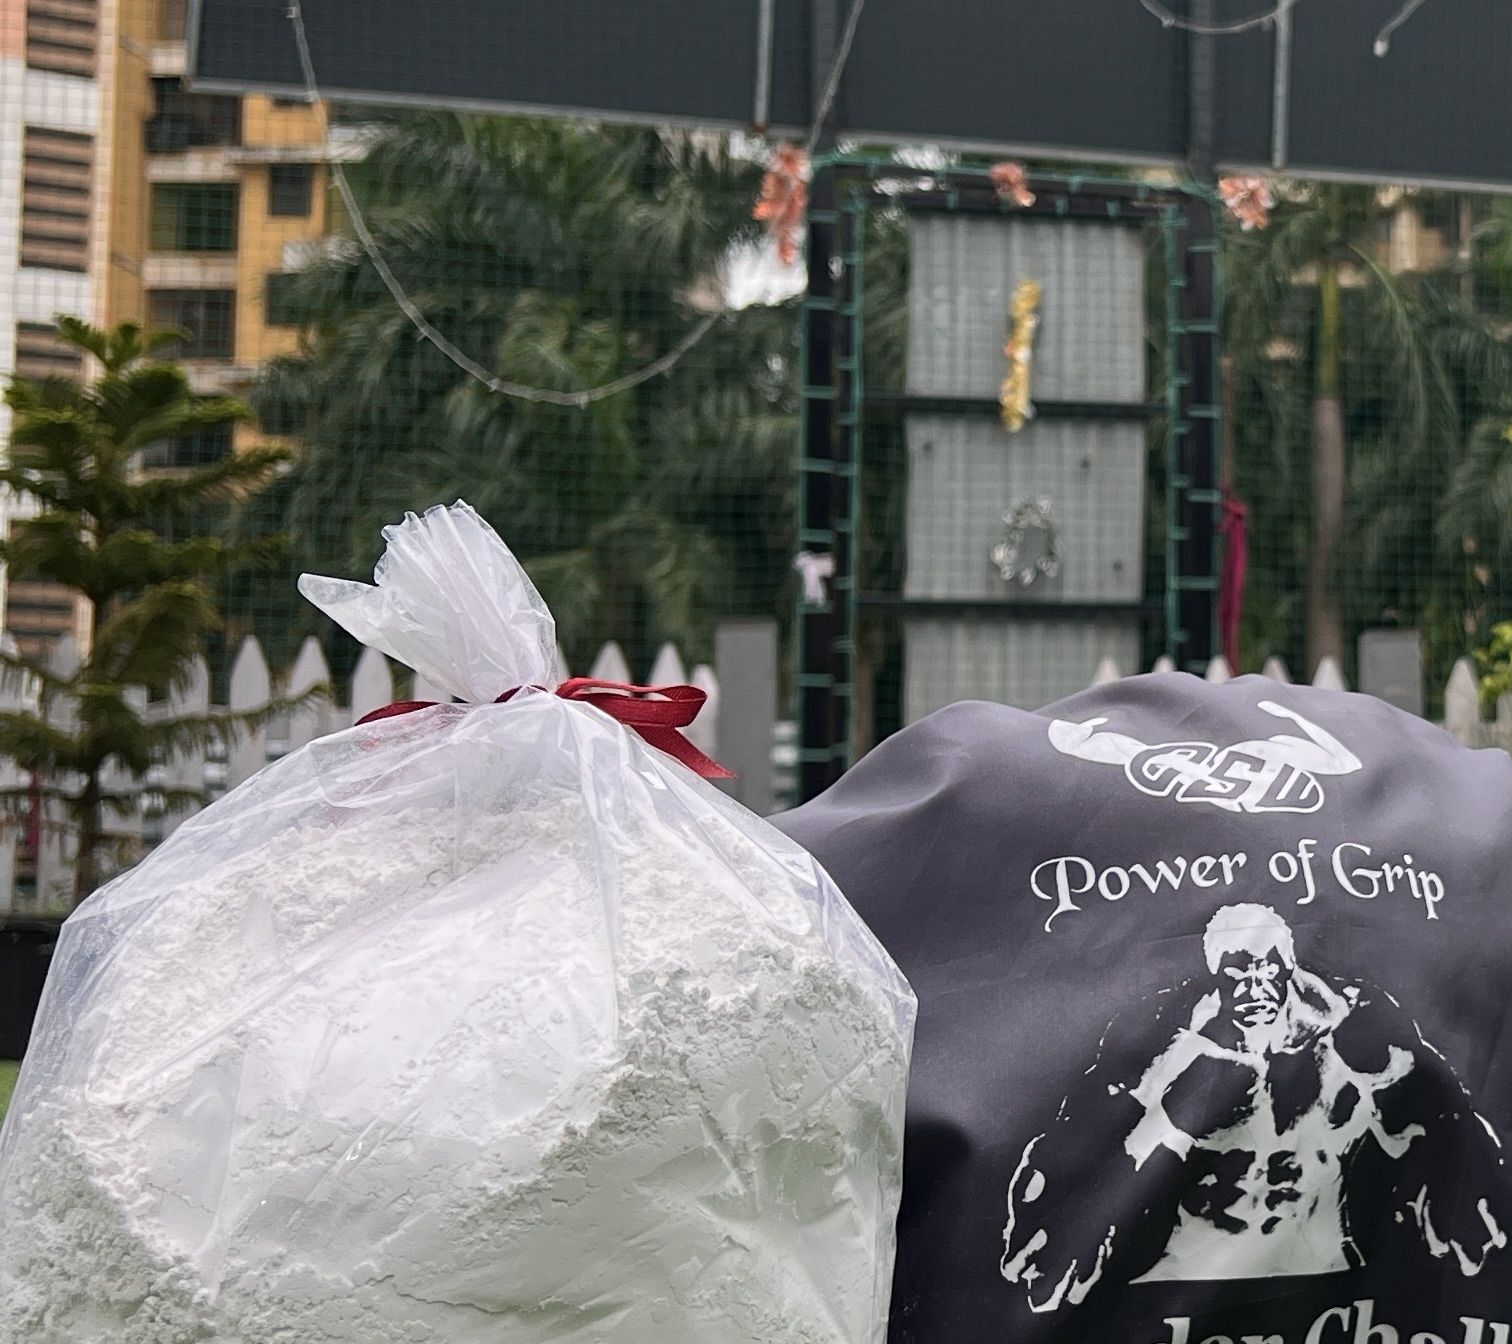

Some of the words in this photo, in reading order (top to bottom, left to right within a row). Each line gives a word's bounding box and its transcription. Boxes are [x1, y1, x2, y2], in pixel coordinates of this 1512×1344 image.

[1030, 851, 1247, 932] Power
[1269, 838, 1318, 905] of
[1331, 841, 1445, 920] Grip
